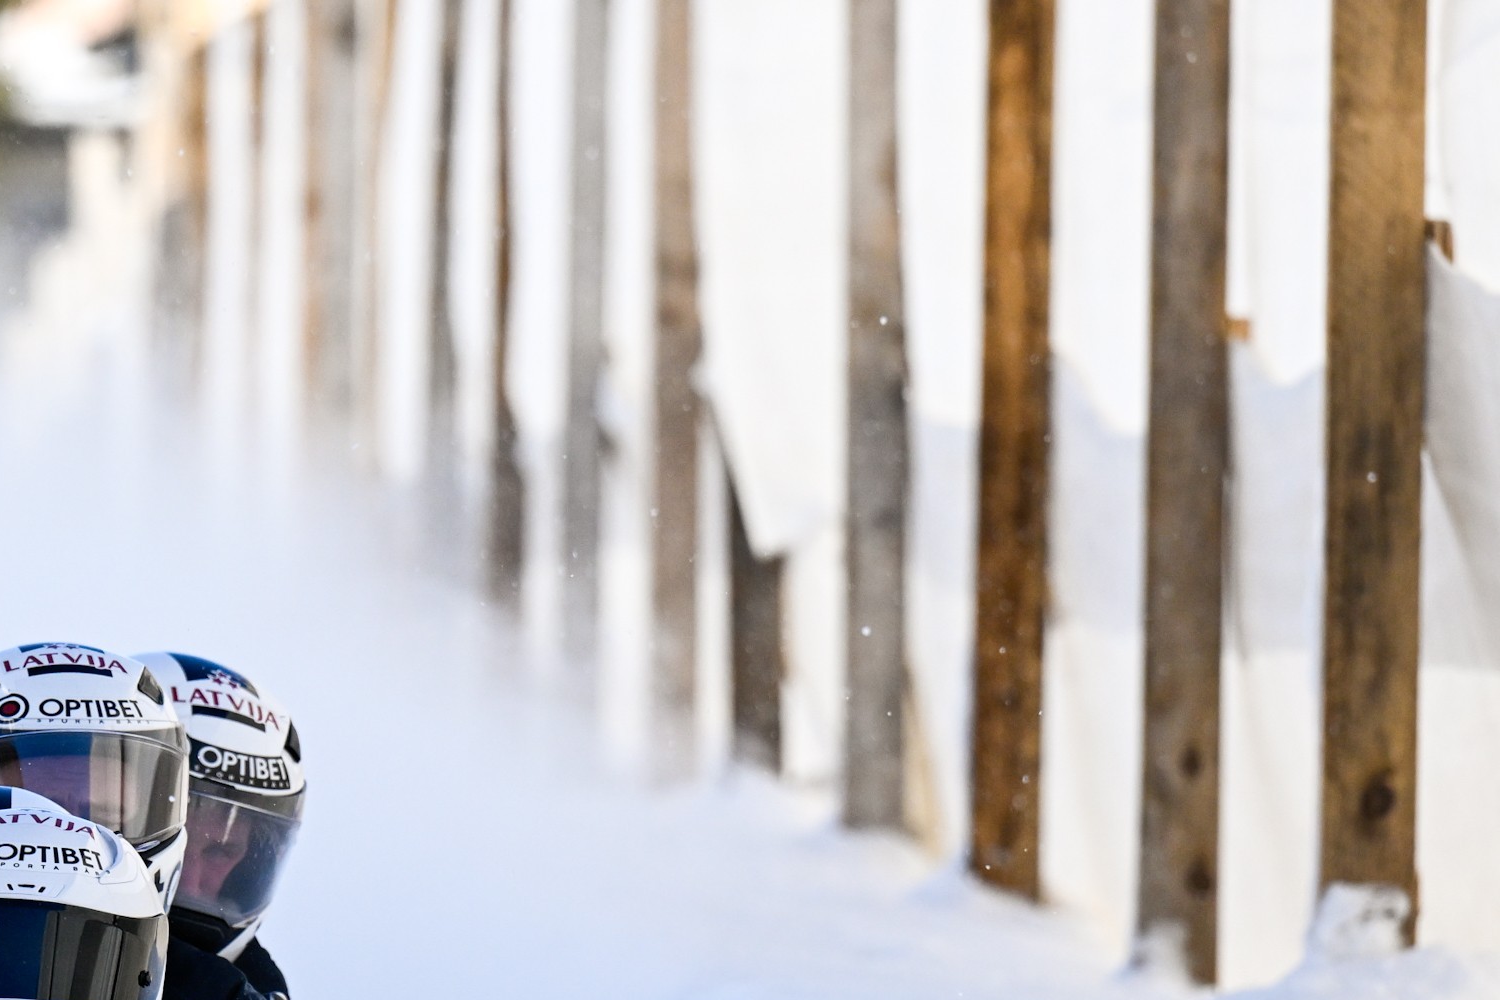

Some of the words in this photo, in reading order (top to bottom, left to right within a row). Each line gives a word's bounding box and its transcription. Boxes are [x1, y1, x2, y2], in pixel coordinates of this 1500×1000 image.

[2, 652, 128, 674] LATVIJA
[38, 698, 144, 718] OPTIBET
[170, 686, 280, 731] LATVIJA
[197, 745, 288, 781] OPTIBET
